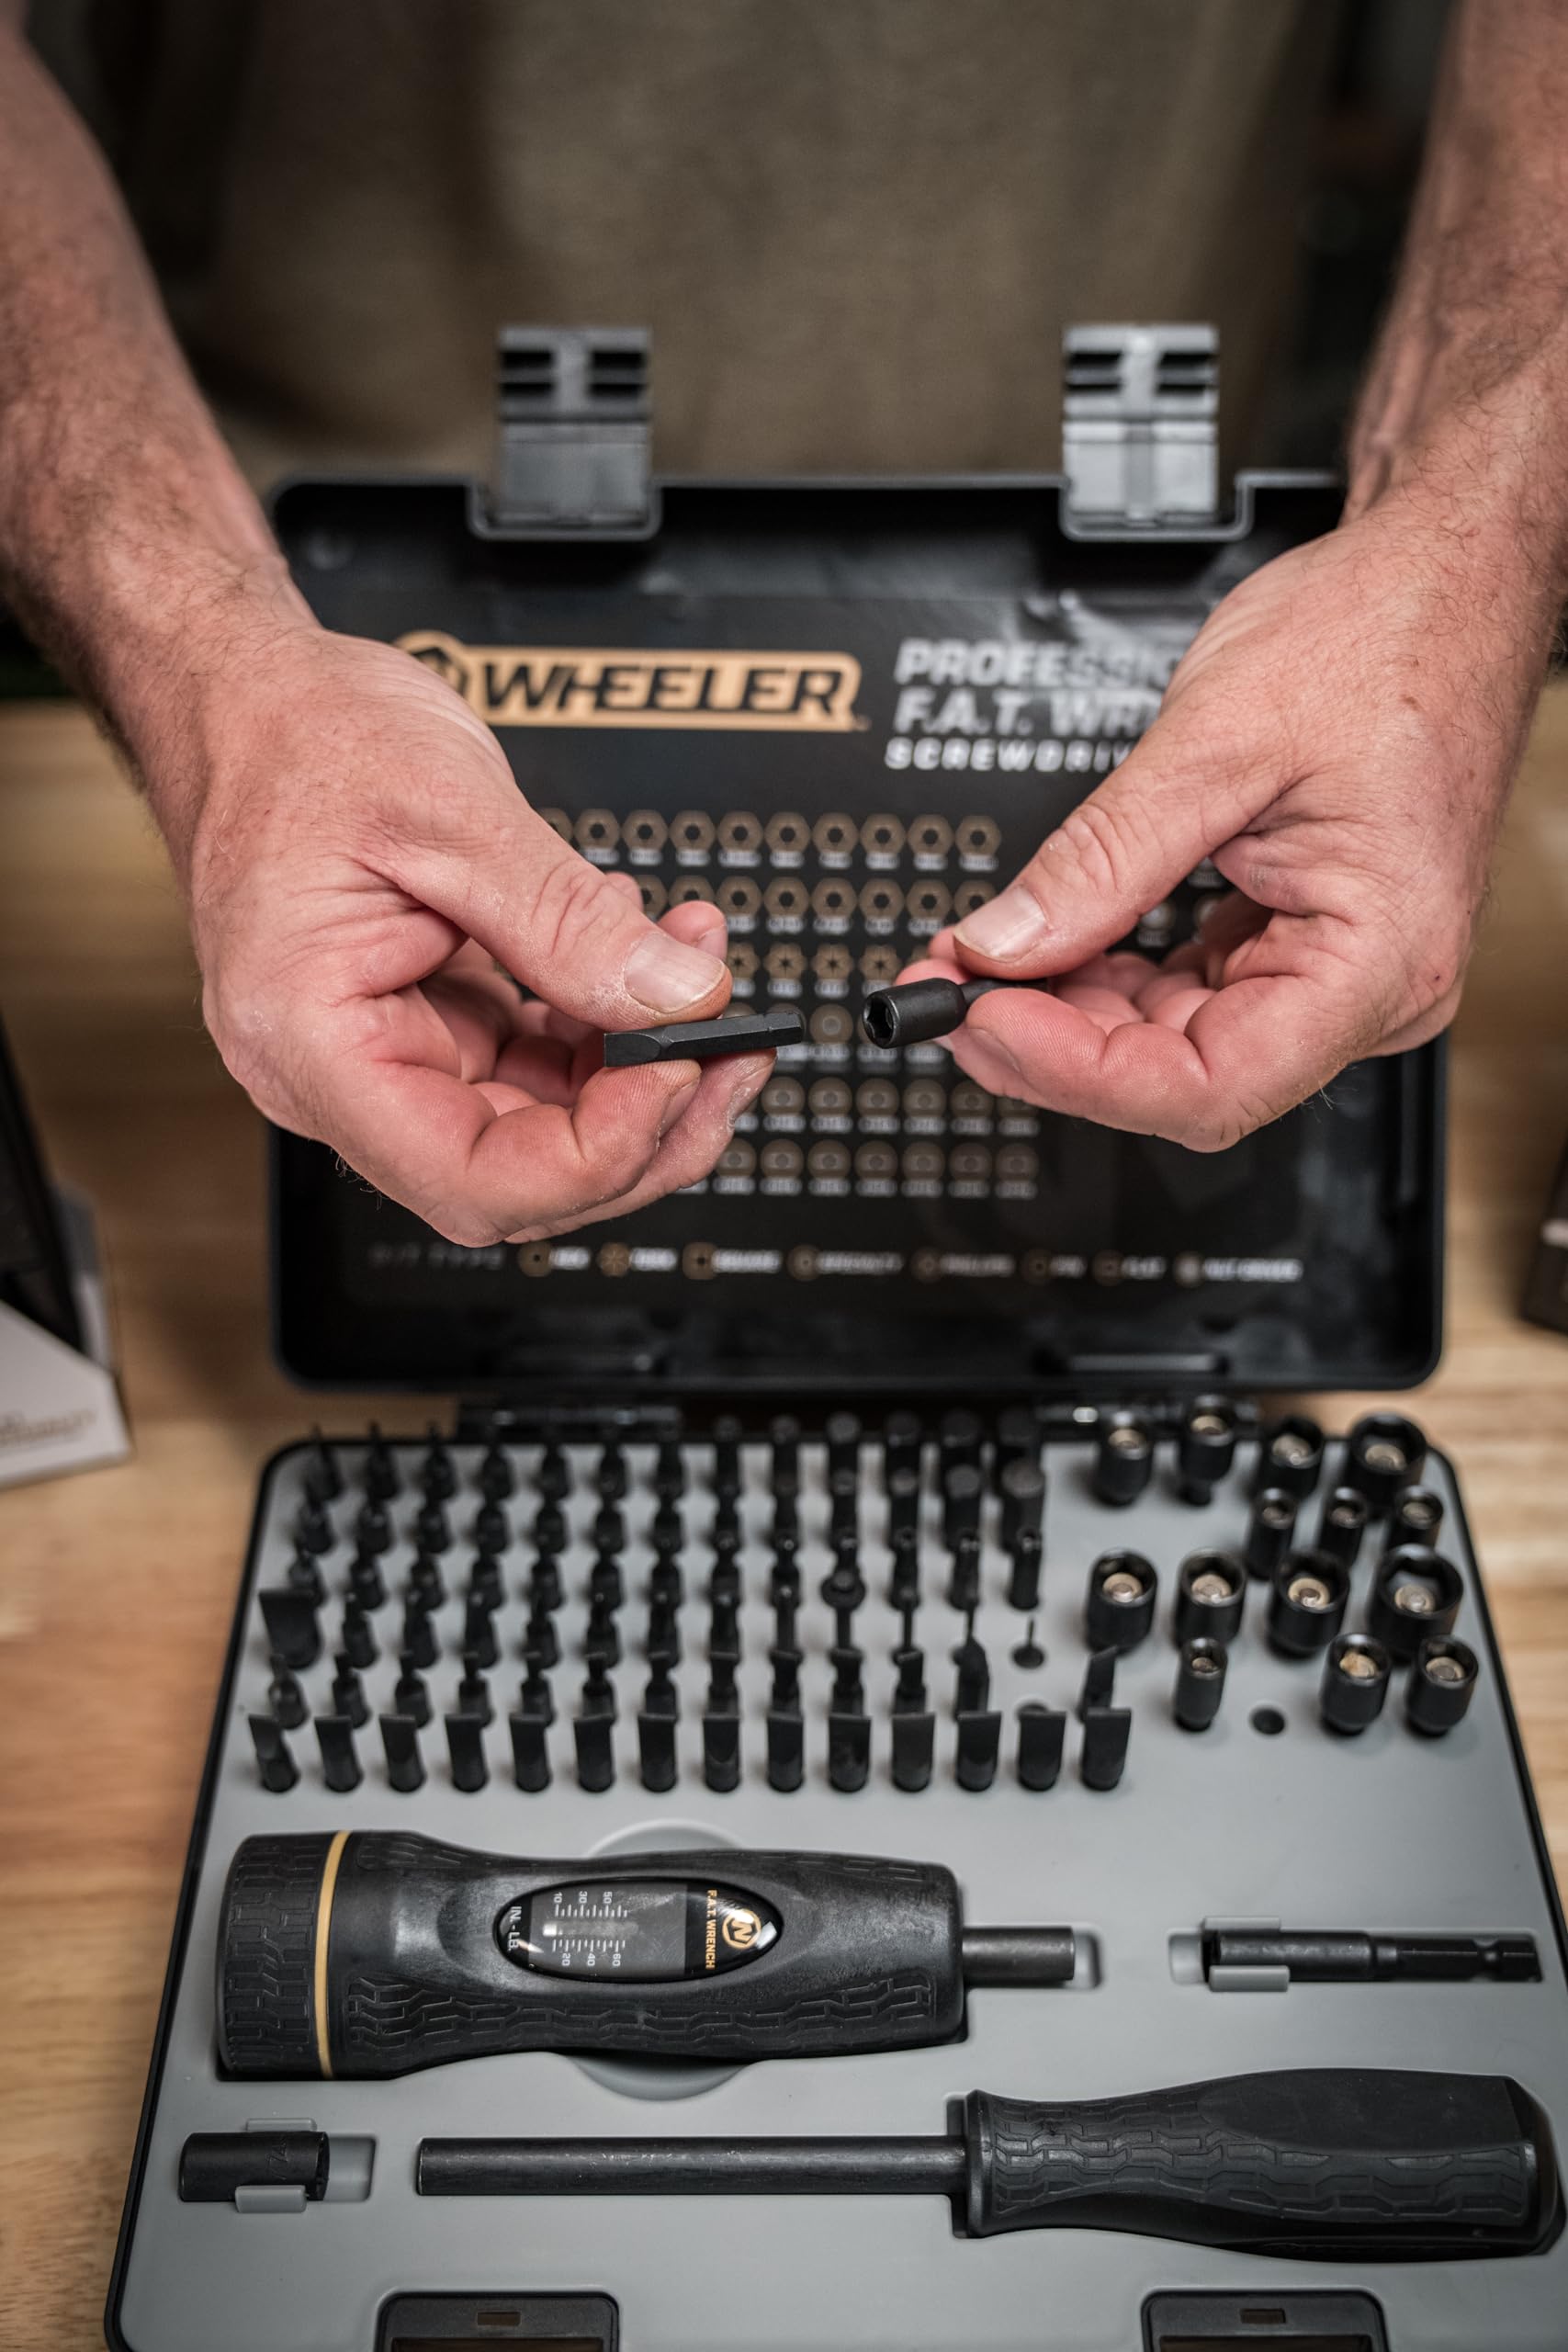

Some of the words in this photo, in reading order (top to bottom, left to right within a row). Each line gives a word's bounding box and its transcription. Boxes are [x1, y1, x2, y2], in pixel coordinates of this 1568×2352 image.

[484, 662, 843, 716] WHEELER
[893, 687, 1033, 734] F.A.T.
[553, 1892, 562, 1904] 10
[578, 1891, 588, 1904] 30
[603, 1891, 613, 1904] 50
[706, 1890, 717, 1918] F.A.T.
[705, 1919, 716, 1969] WRENCH
[561, 1953, 570, 1966] 20
[587, 1953, 596, 1966] 40
[612, 1953, 621, 1966] 60
